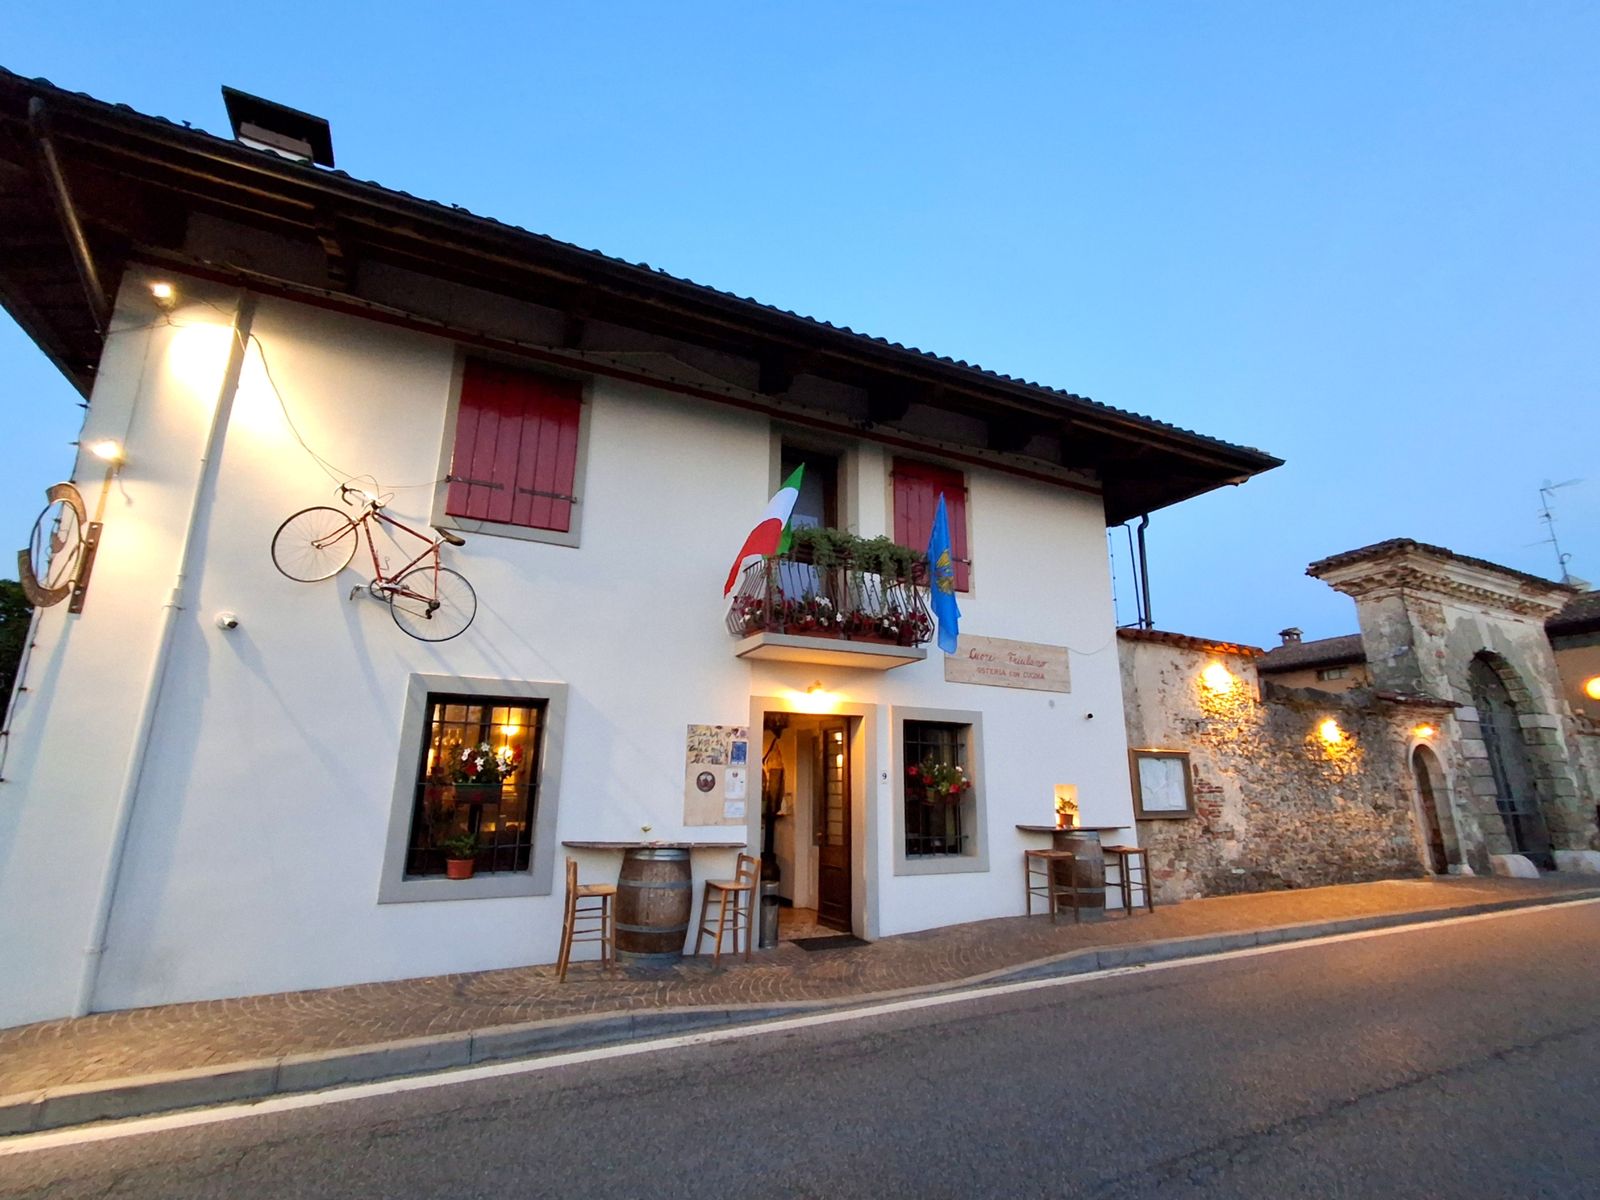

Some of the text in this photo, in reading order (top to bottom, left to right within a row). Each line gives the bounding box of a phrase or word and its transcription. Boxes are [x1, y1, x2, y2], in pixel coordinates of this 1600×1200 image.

[969, 648, 995, 661] Cuore
[976, 667, 1006, 676] OSTERIA
[1023, 671, 1045, 679] CUCINA
[882, 772, 887, 780] 9
